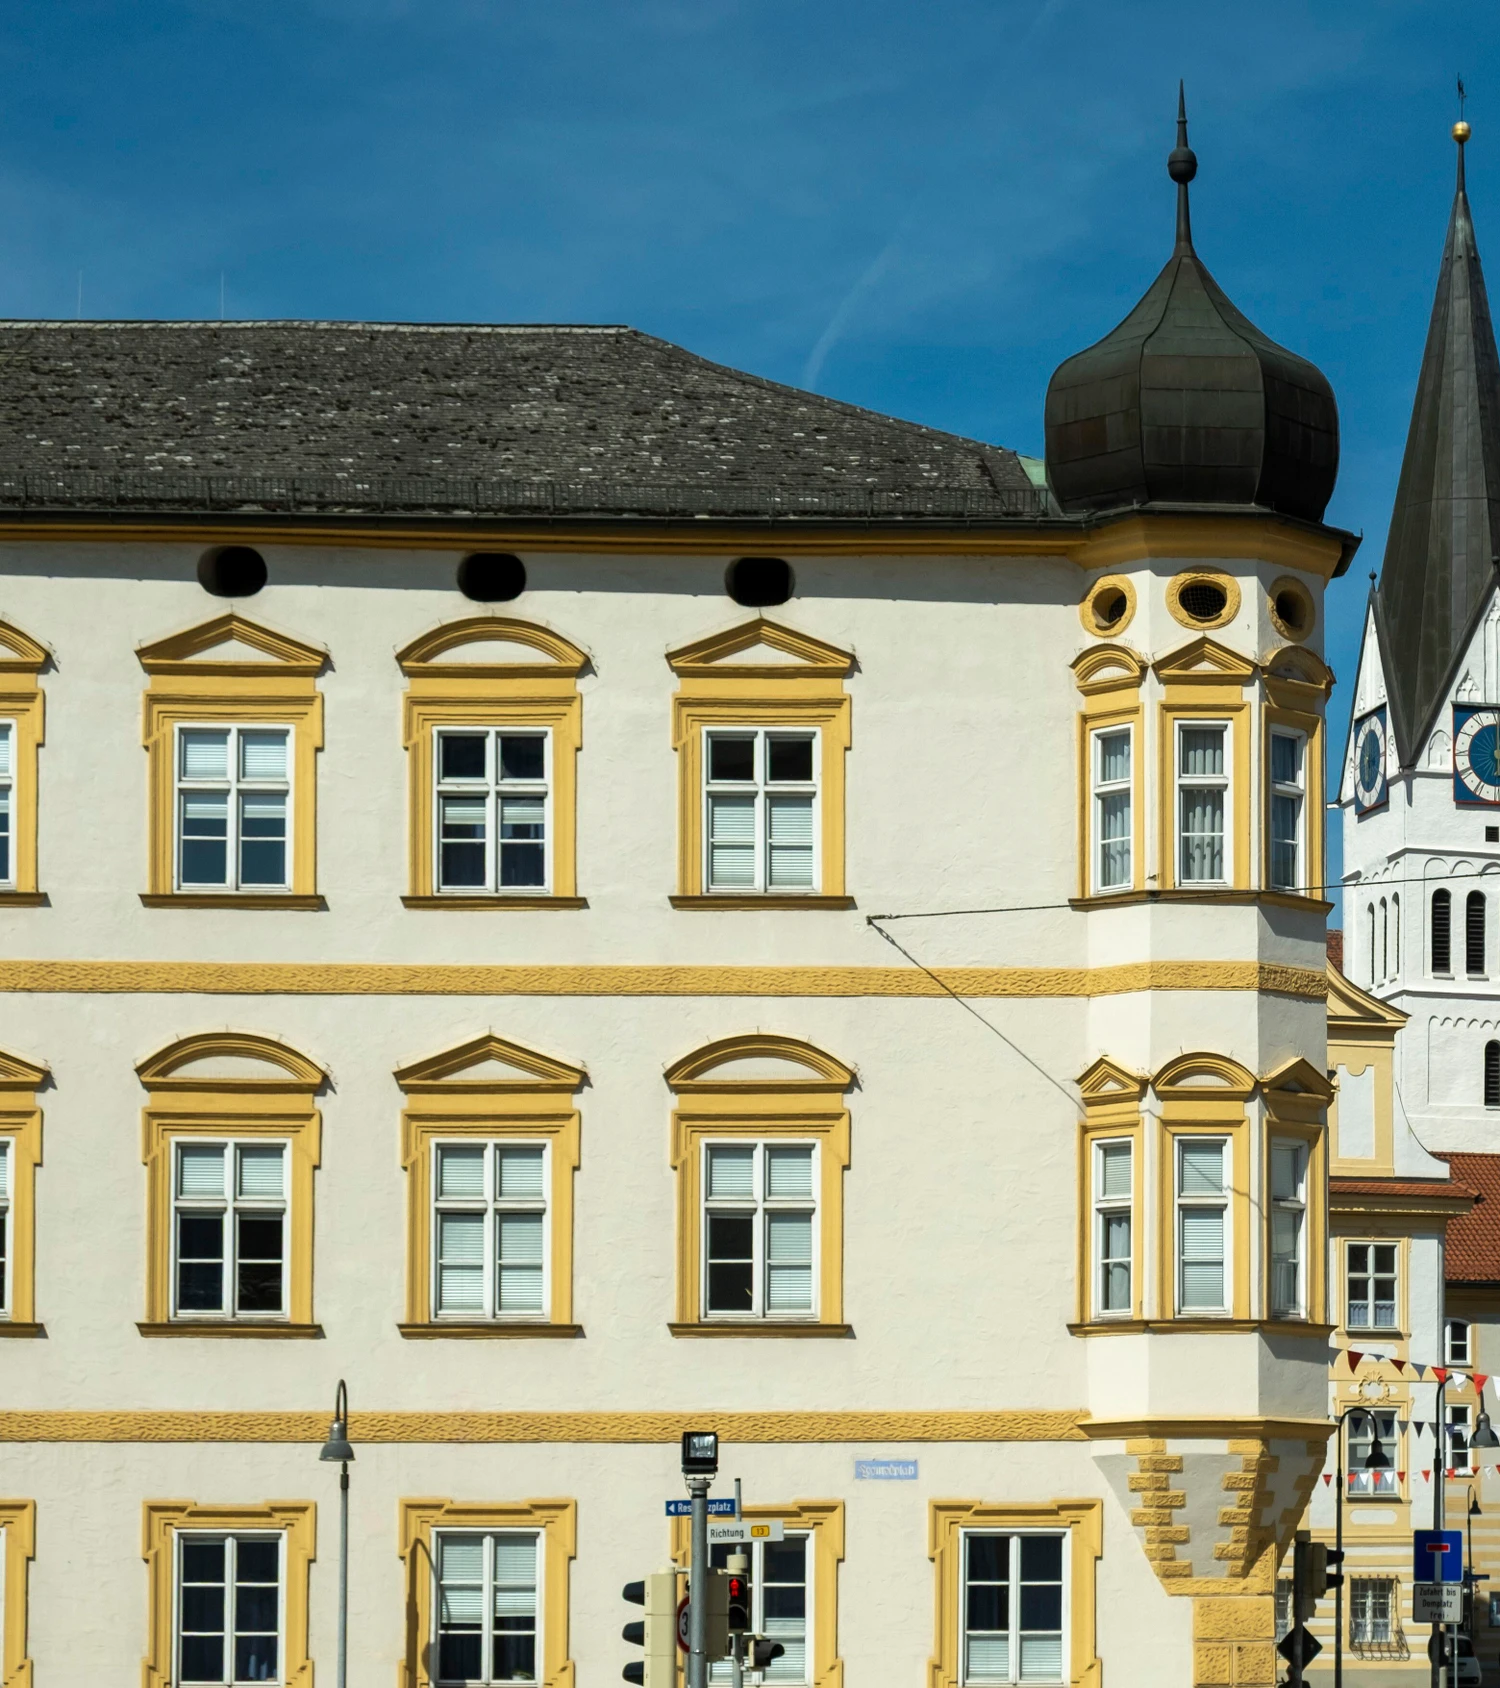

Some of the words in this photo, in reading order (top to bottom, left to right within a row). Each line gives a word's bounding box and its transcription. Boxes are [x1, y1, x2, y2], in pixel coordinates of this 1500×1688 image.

[678, 1501, 731, 1513] Reszplatz
[710, 1528, 744, 1539] Richtung
[756, 1527, 765, 1535] 13
[1419, 1587, 1443, 1596] Zufahrt
[1446, 1587, 1456, 1596] bis
[1422, 1599, 1453, 1608] Domplatz
[1430, 1611, 1445, 1620] frei
